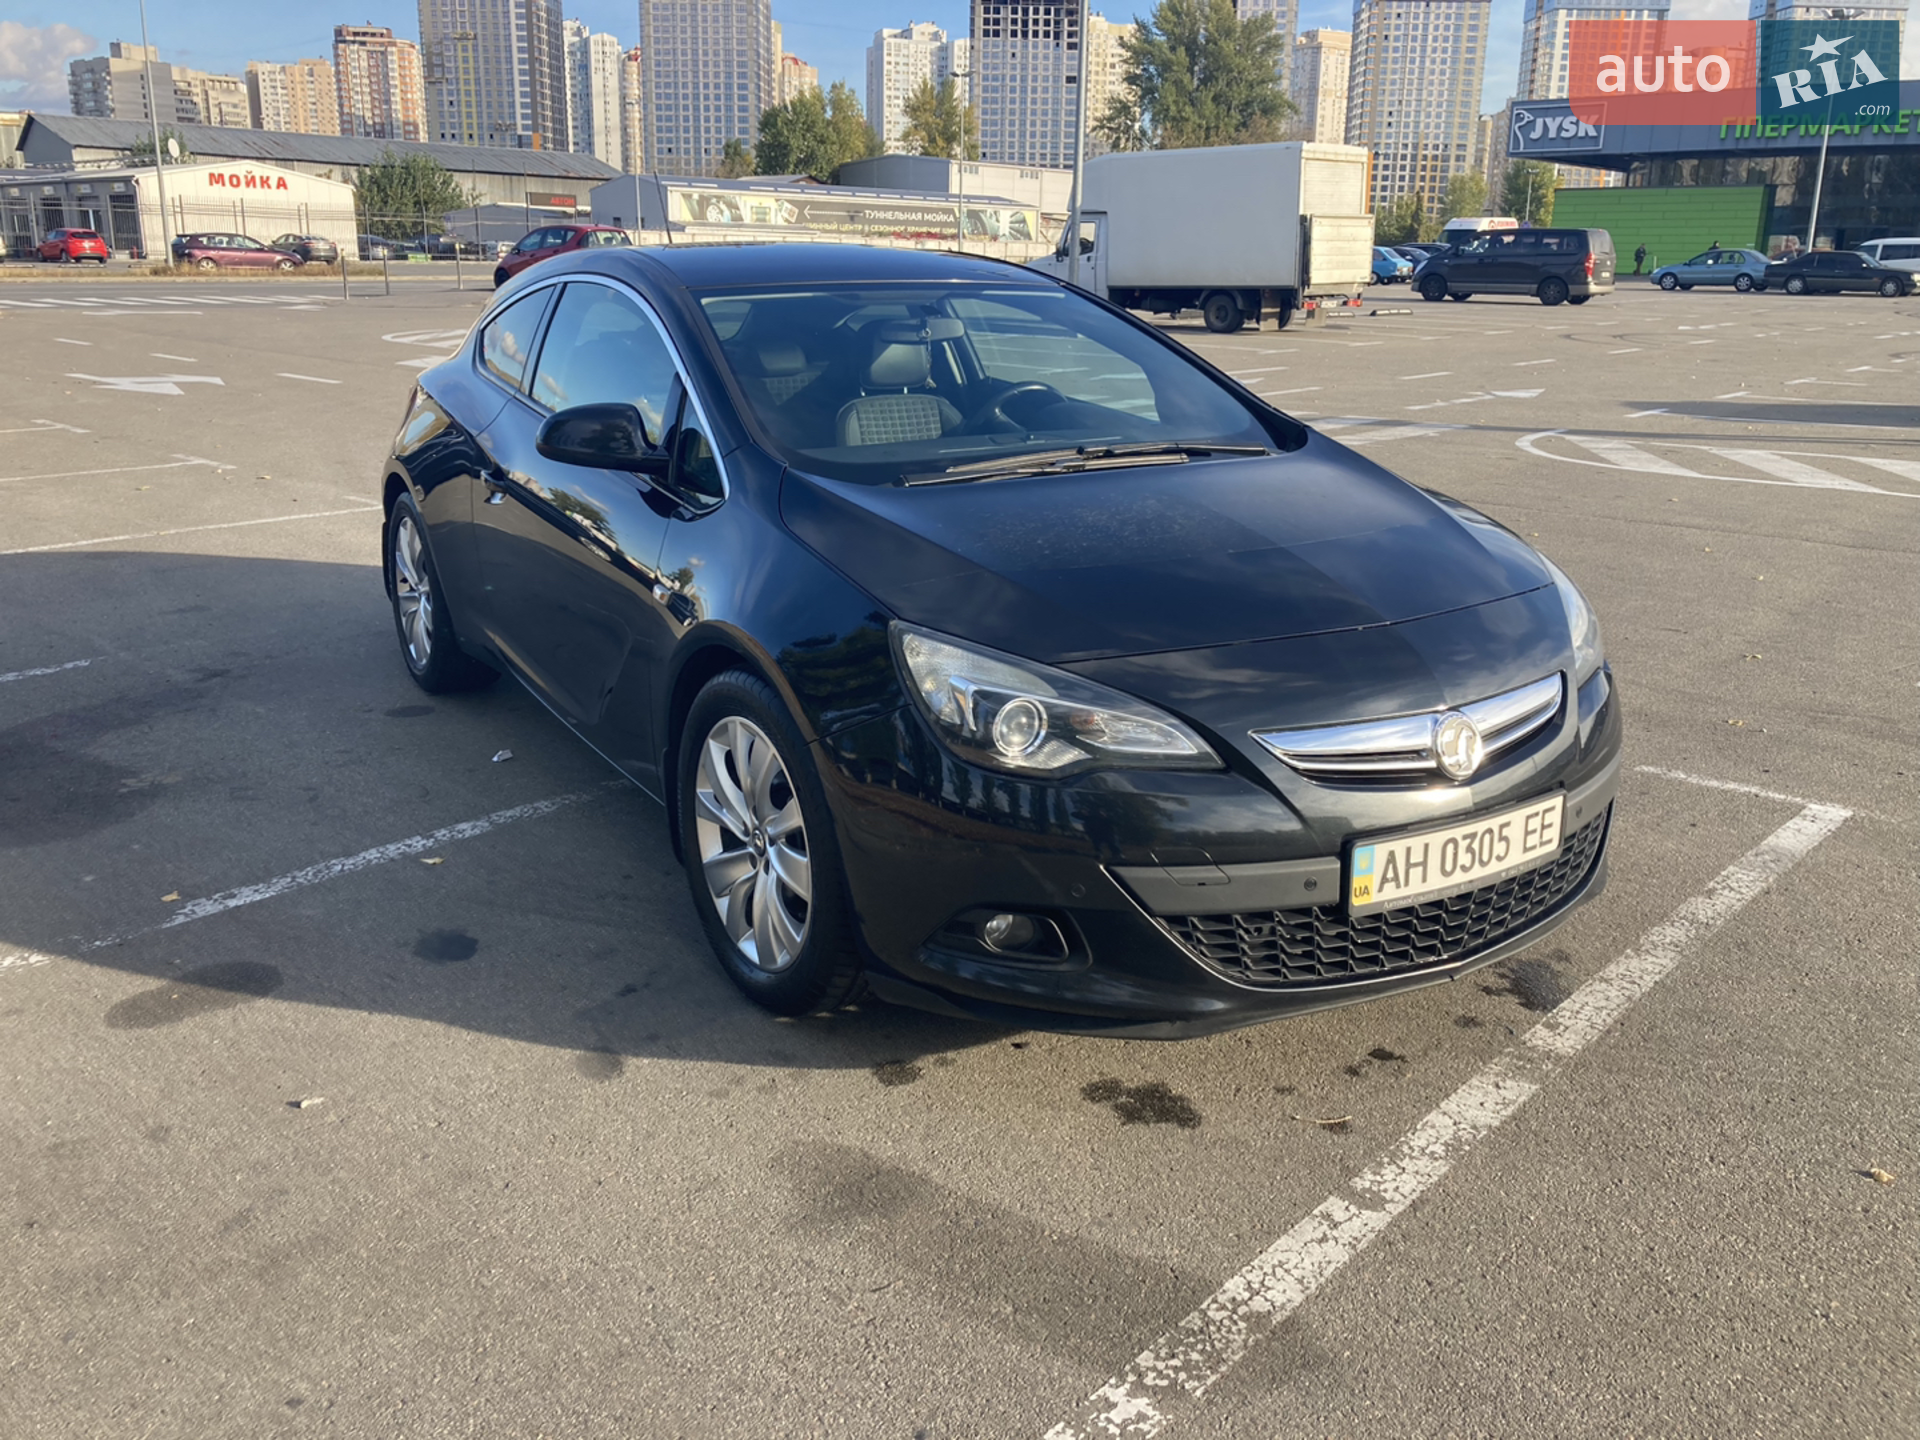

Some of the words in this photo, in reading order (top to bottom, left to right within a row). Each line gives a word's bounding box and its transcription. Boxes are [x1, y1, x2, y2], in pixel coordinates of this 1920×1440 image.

[1529, 114, 1600, 140] JYSK
[208, 170, 289, 191] МОЙКА
[864, 209, 923, 221] ТУННЕЛЬНАЯ
[923, 212, 955, 223] МОЙКА
[1377, 843, 1430, 893] AH
[1439, 821, 1512, 878] 0305
[1522, 806, 1557, 853] EE
[1354, 883, 1371, 898] UA
